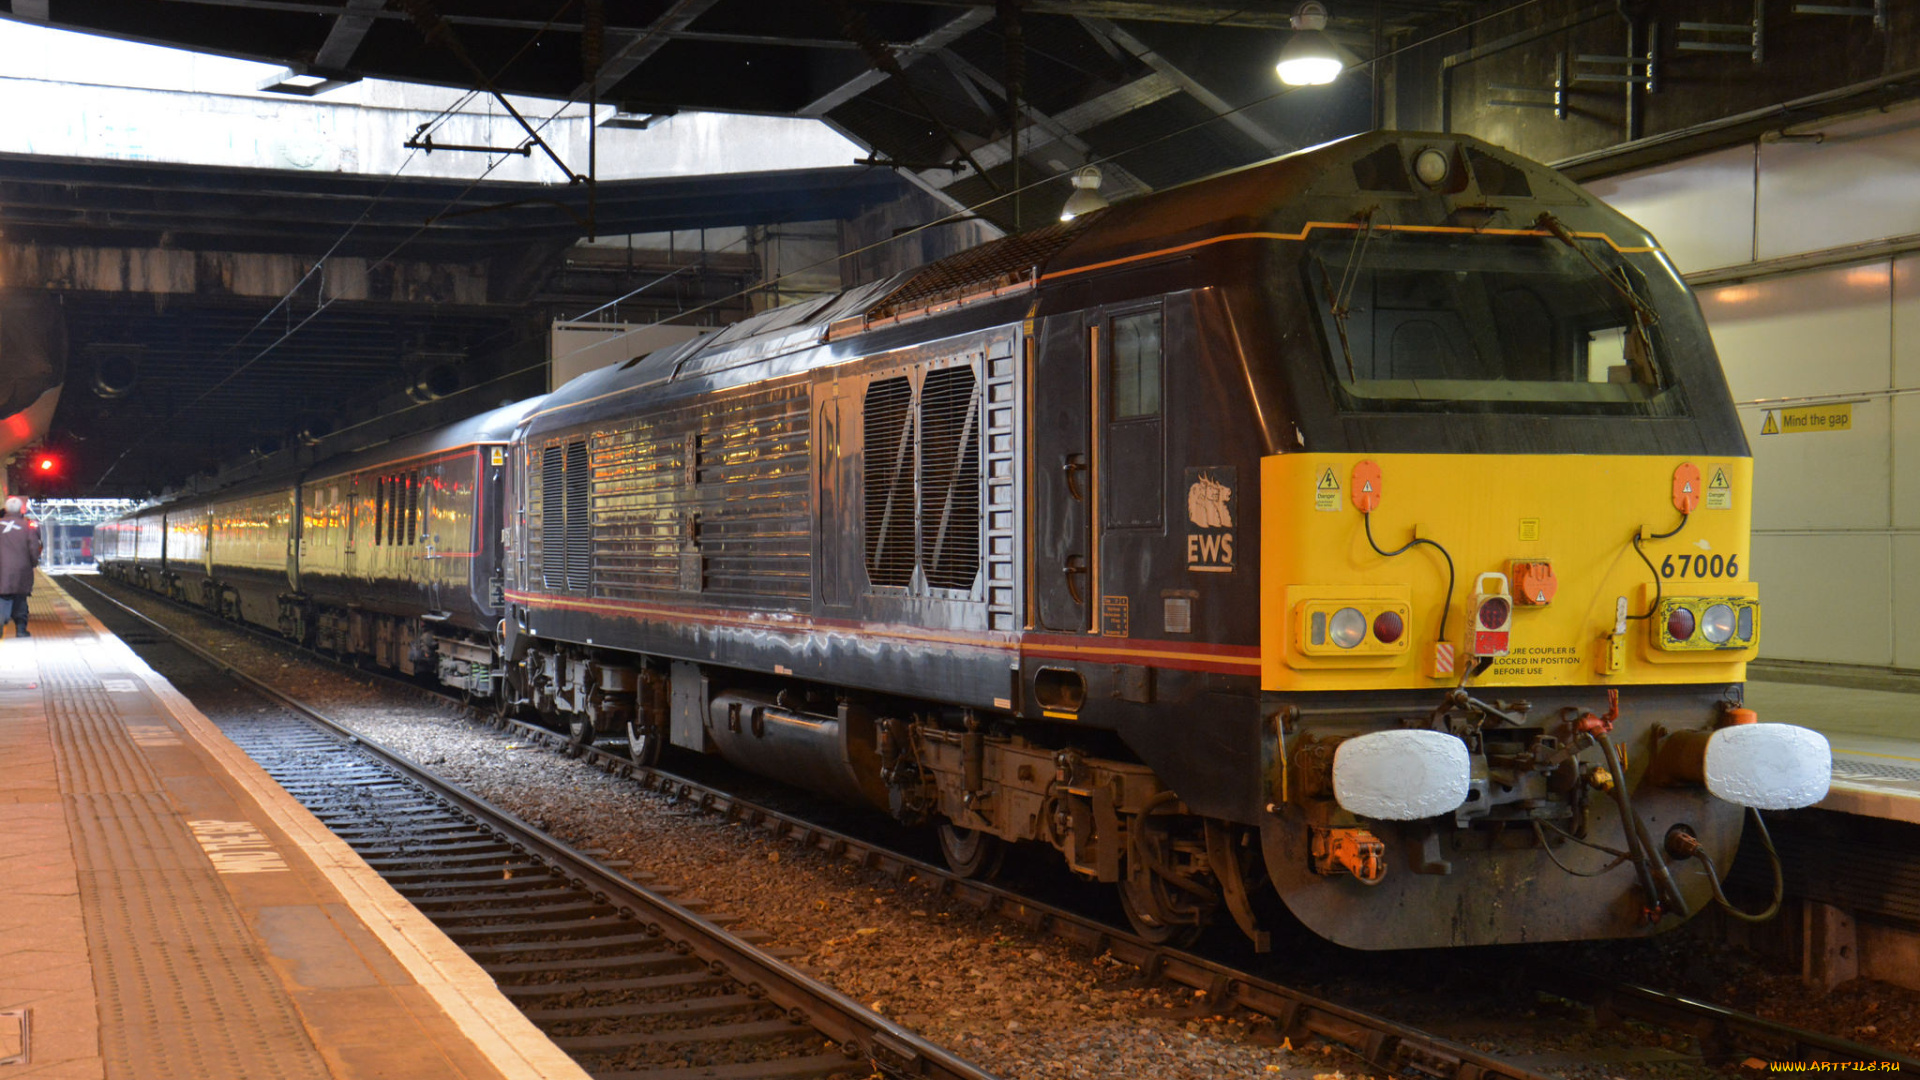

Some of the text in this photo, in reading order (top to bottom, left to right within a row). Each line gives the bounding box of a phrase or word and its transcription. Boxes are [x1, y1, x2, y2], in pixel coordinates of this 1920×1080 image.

[1784, 414, 1848, 427] Mind the gap
[1187, 533, 1233, 564] EWS
[1661, 553, 1739, 578] 67006
